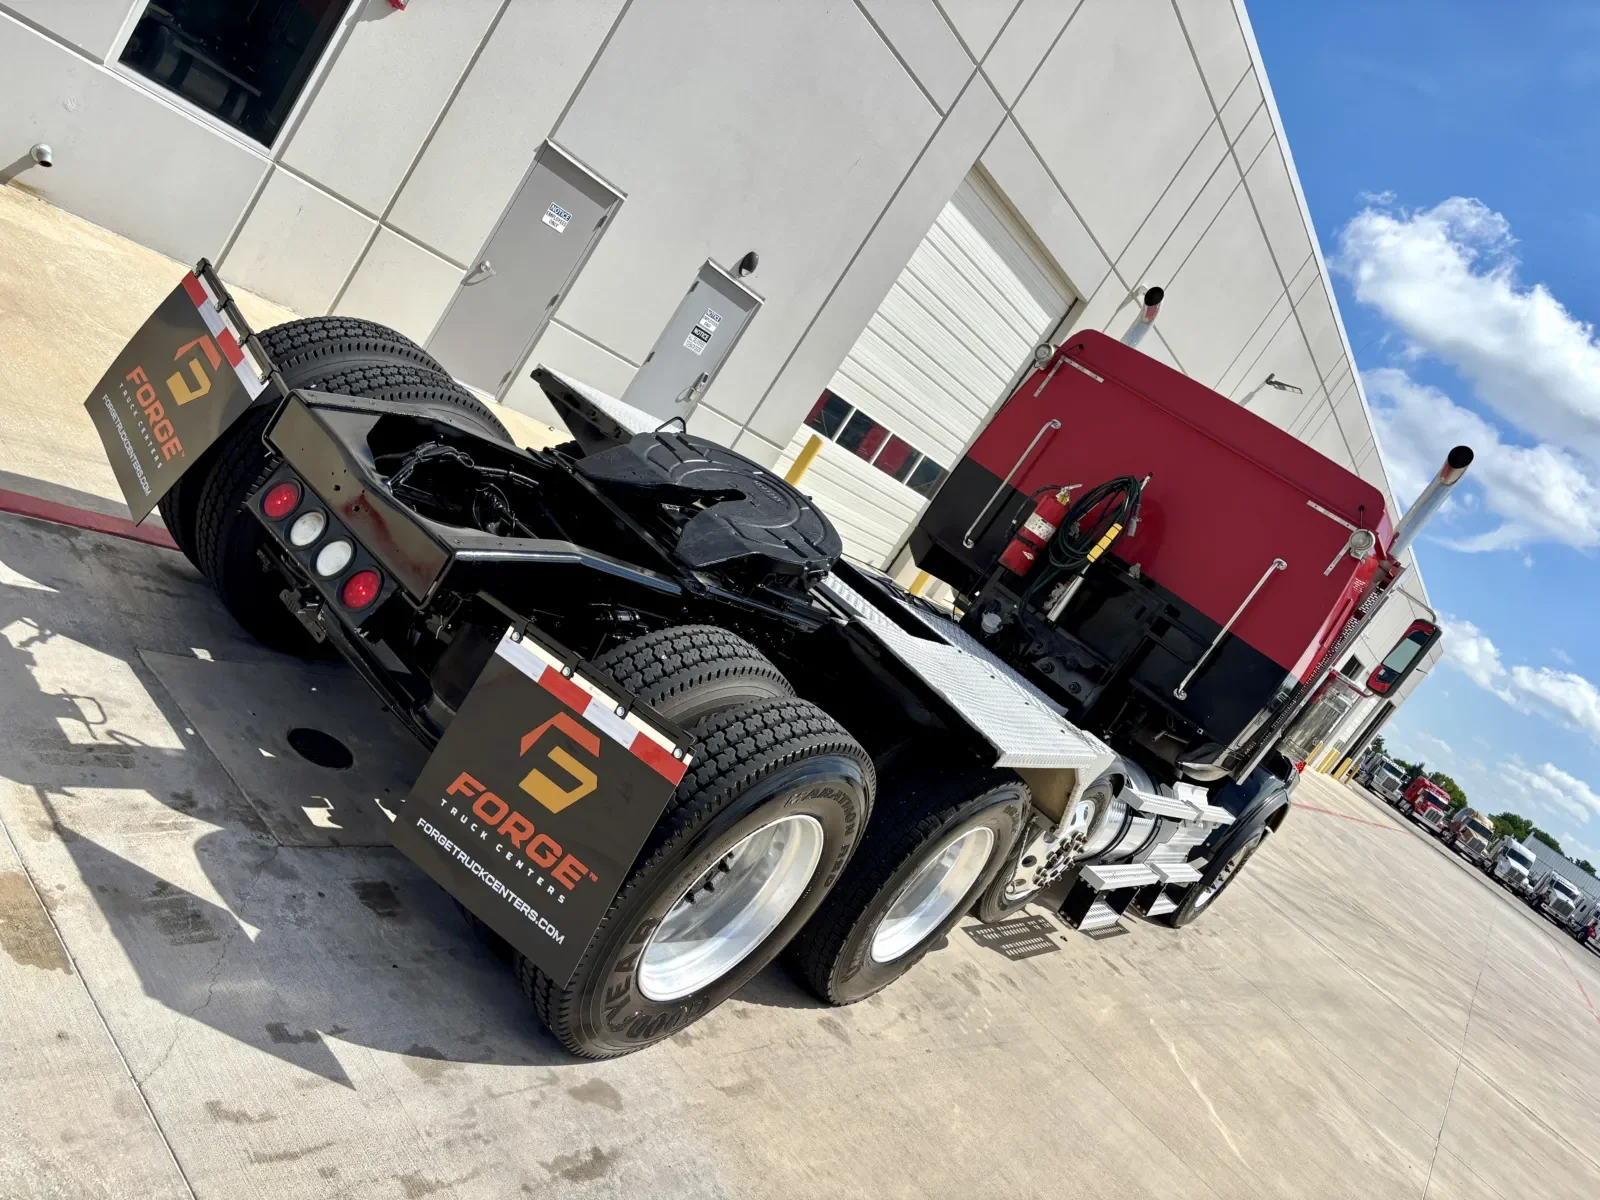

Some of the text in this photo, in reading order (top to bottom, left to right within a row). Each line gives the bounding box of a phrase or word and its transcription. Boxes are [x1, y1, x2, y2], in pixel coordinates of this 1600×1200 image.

[550, 203, 571, 222] NOTICE
[101, 393, 152, 497] FORGETRUCKCENTERS.COM
[119, 382, 163, 469] TRUCK CENTERS
[125, 365, 183, 462] FORGE
[440, 798, 566, 904] TRUCK CENTERS
[446, 771, 588, 891] FORGE
[783, 786, 858, 837] MARATHON
[416, 817, 566, 946] FORGETRUCKCENTERS.COM
